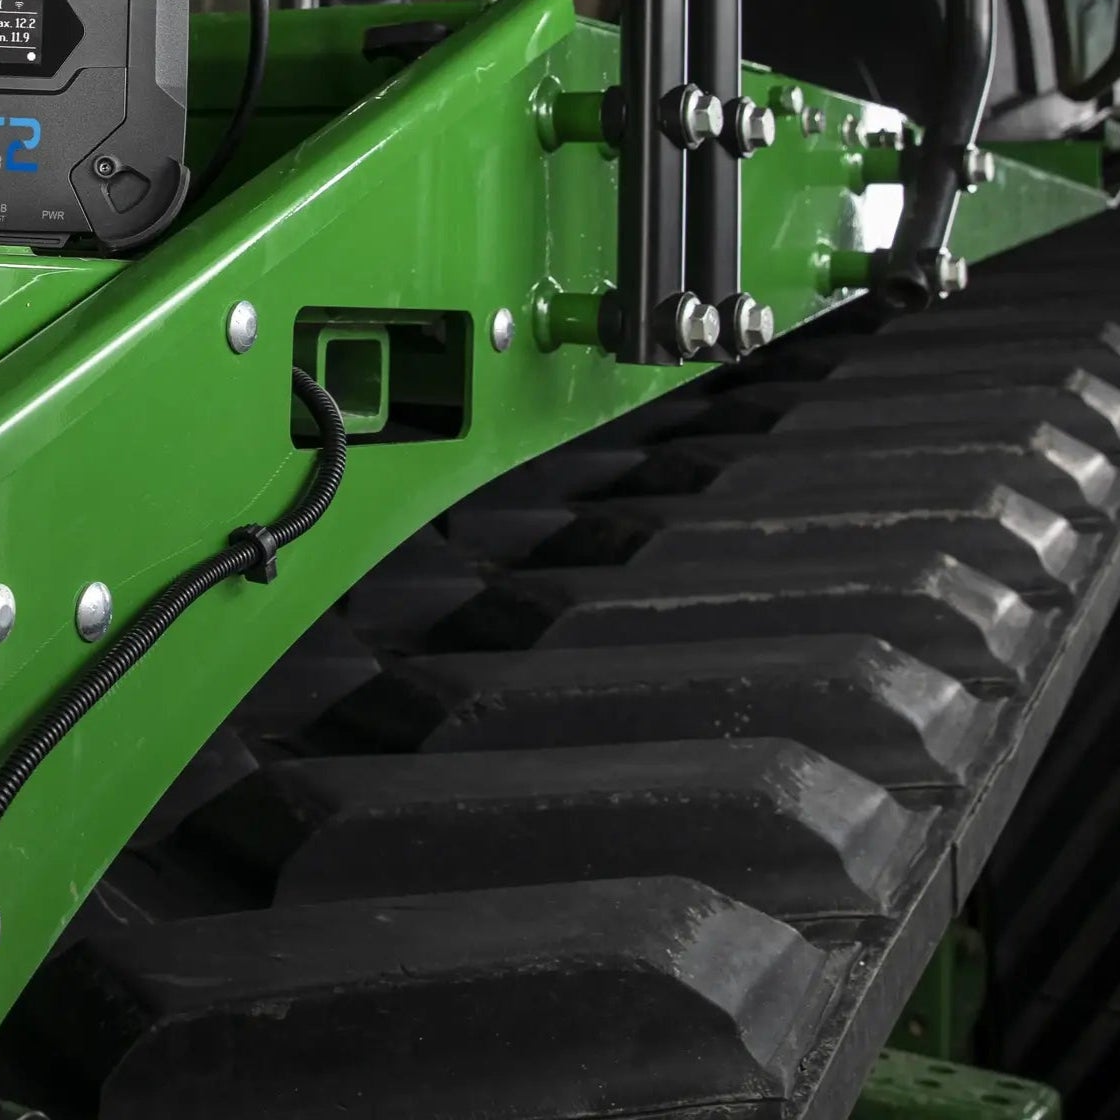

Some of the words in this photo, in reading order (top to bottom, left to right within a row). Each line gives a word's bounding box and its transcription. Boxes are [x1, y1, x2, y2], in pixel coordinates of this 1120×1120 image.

[15, 18, 36, 29] 12.2
[11, 32, 30, 43] 11.9
[42, 210, 65, 221] PWR
